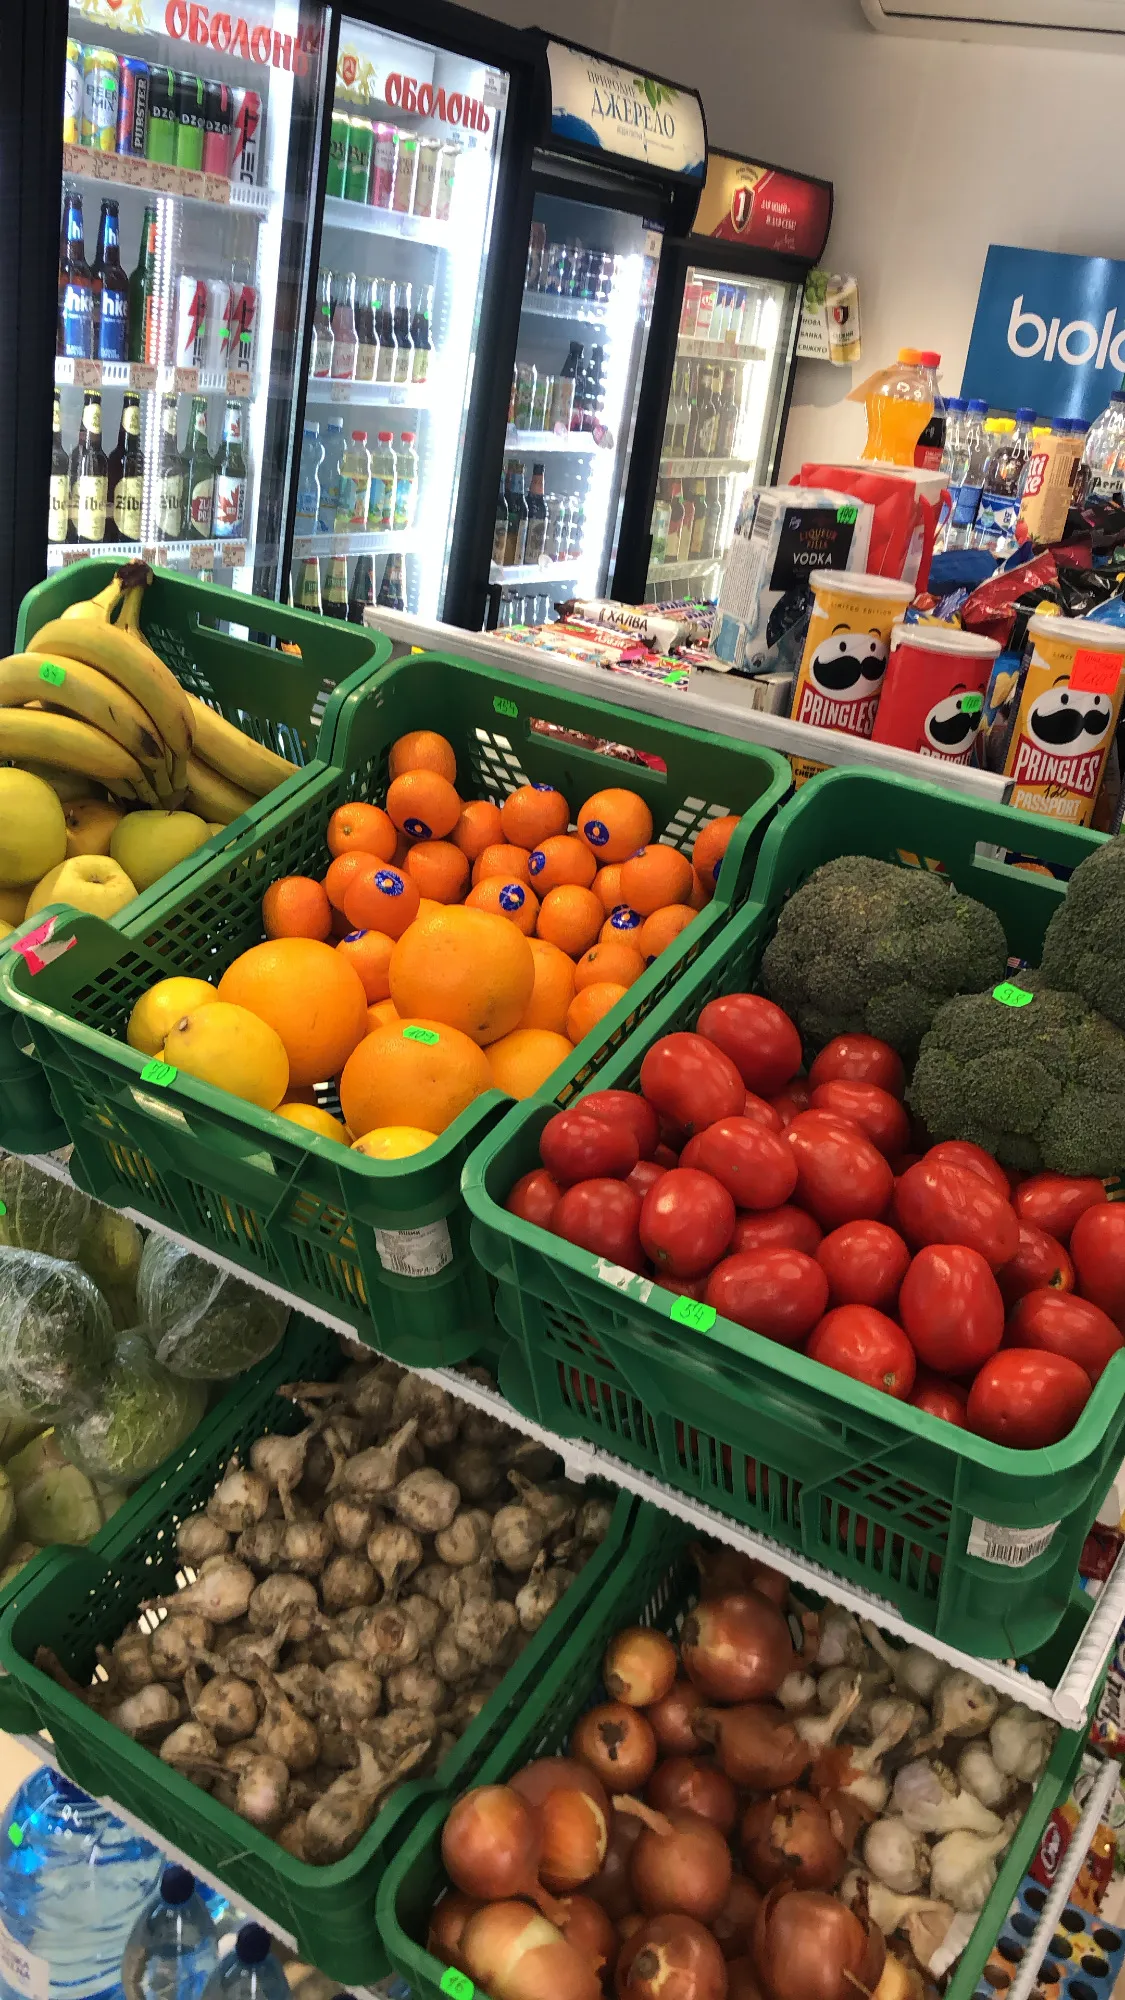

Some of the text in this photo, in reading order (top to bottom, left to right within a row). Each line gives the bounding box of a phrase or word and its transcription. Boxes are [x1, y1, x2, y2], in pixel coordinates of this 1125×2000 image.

[165, 0, 309, 77] ОБОЛОНЬ
[92, 96, 115, 113] MIX
[132, 77, 148, 149] PUBSTER
[385, 71, 490, 134] ОБОЛОНЬ
[591, 87, 676, 140] ДЖЕРЕЛО
[802, 318, 822, 327] НОВА
[798, 343, 828, 354] СВІЖОГО
[792, 551, 833, 566] VODKA
[606, 607, 649, 632] ХАЛВА
[830, 602, 893, 617] LIMITED EDITION
[800, 691, 877, 736] PRINGLES
[1015, 743, 1101, 793] PRINGLES
[1013, 787, 1082, 818] PASSPORT
